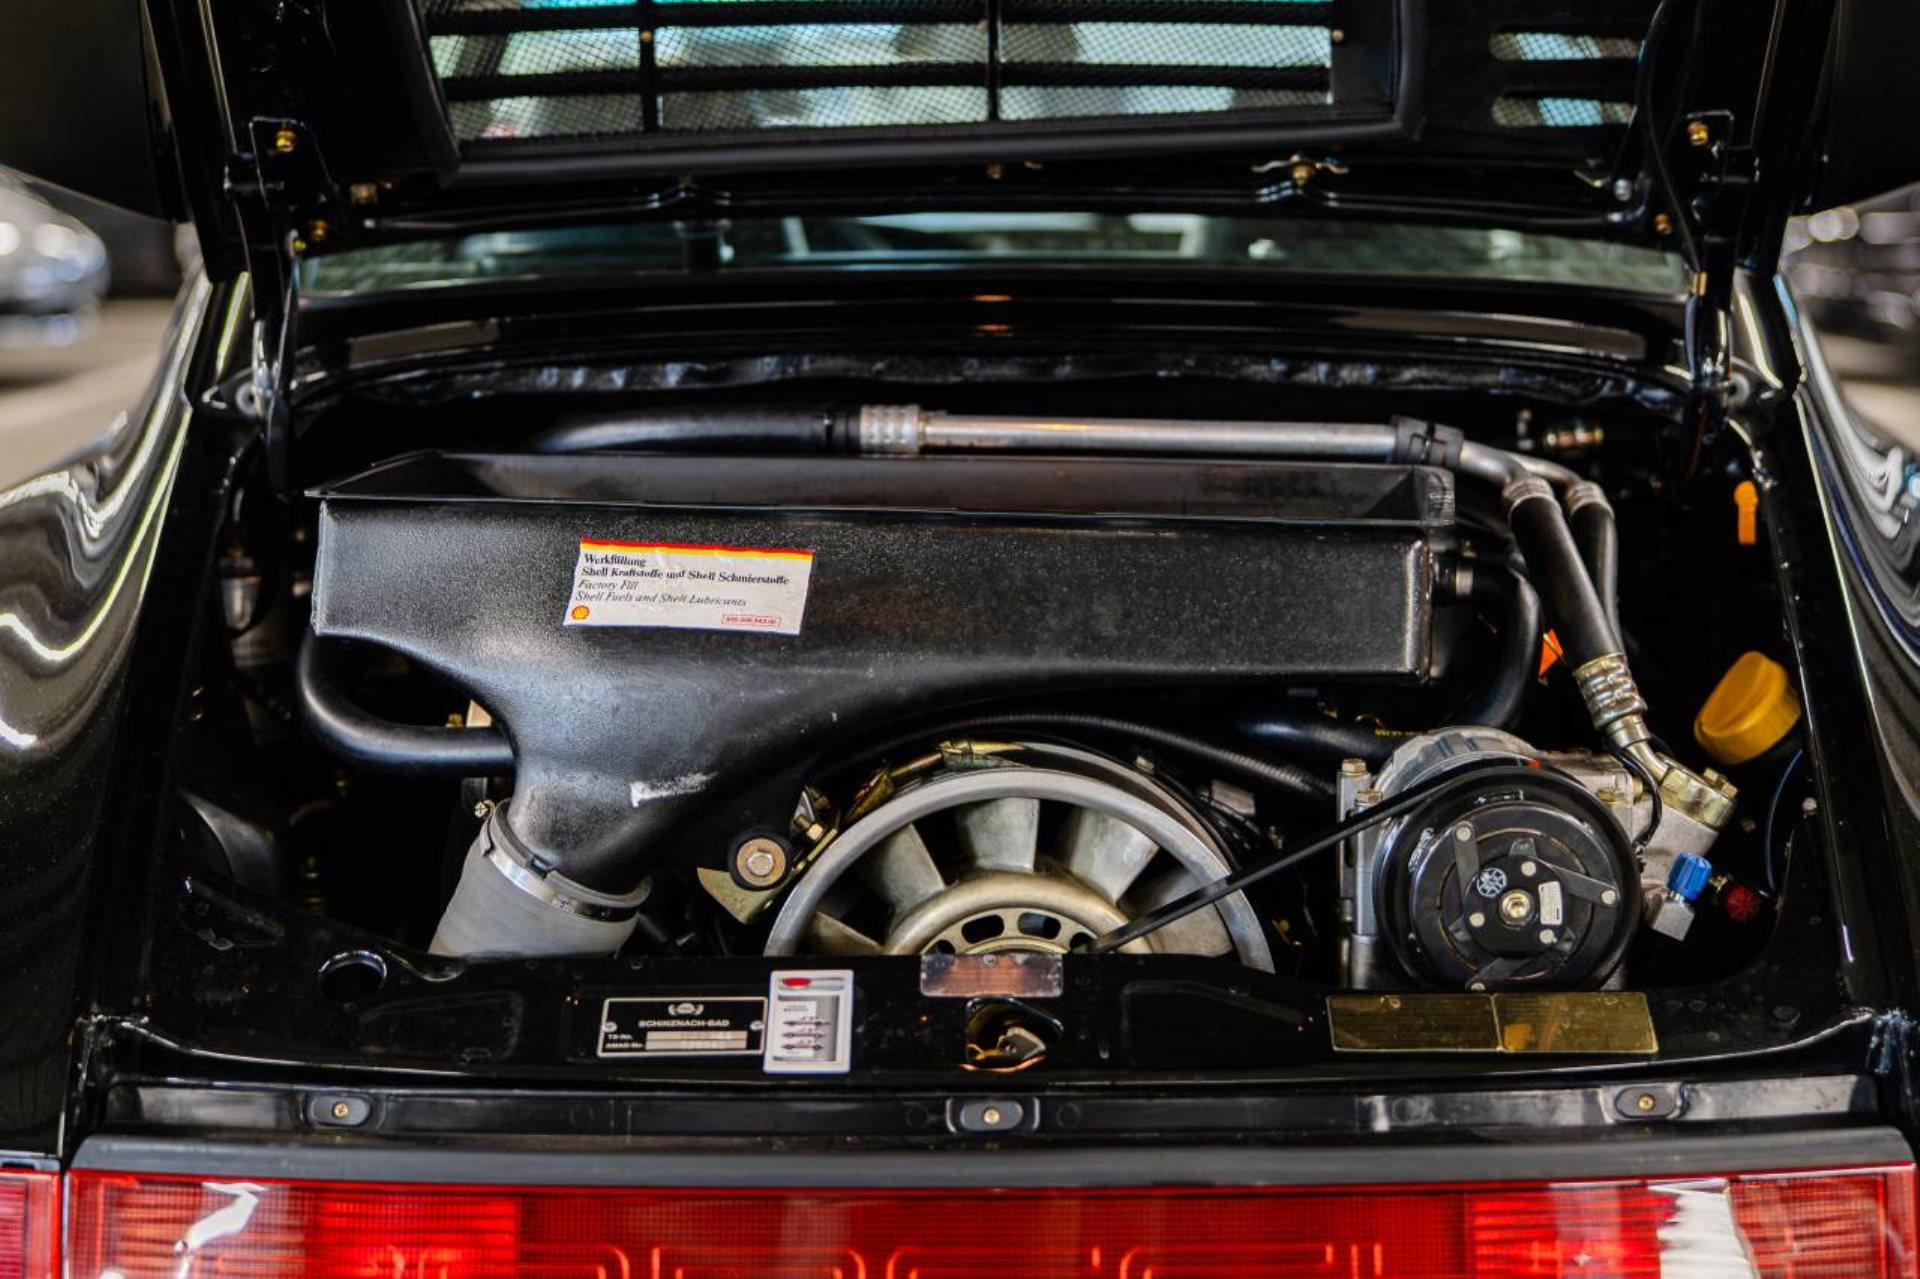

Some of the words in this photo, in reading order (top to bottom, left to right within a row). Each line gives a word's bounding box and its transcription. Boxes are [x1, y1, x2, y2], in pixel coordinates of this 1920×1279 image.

[584, 553, 647, 567] Werkfüllung
[581, 567, 608, 577] Shell
[611, 568, 664, 579] Kraftstoffe
[688, 571, 715, 581] Shell
[719, 572, 790, 585] Schmierstoffe
[578, 579, 617, 591] Factory
[619, 580, 638, 590] Fill
[575, 590, 603, 601] Shell
[604, 591, 632, 602] Fuels
[635, 592, 656, 603] and
[658, 593, 687, 603] Shell
[689, 593, 747, 607] Lubricants
